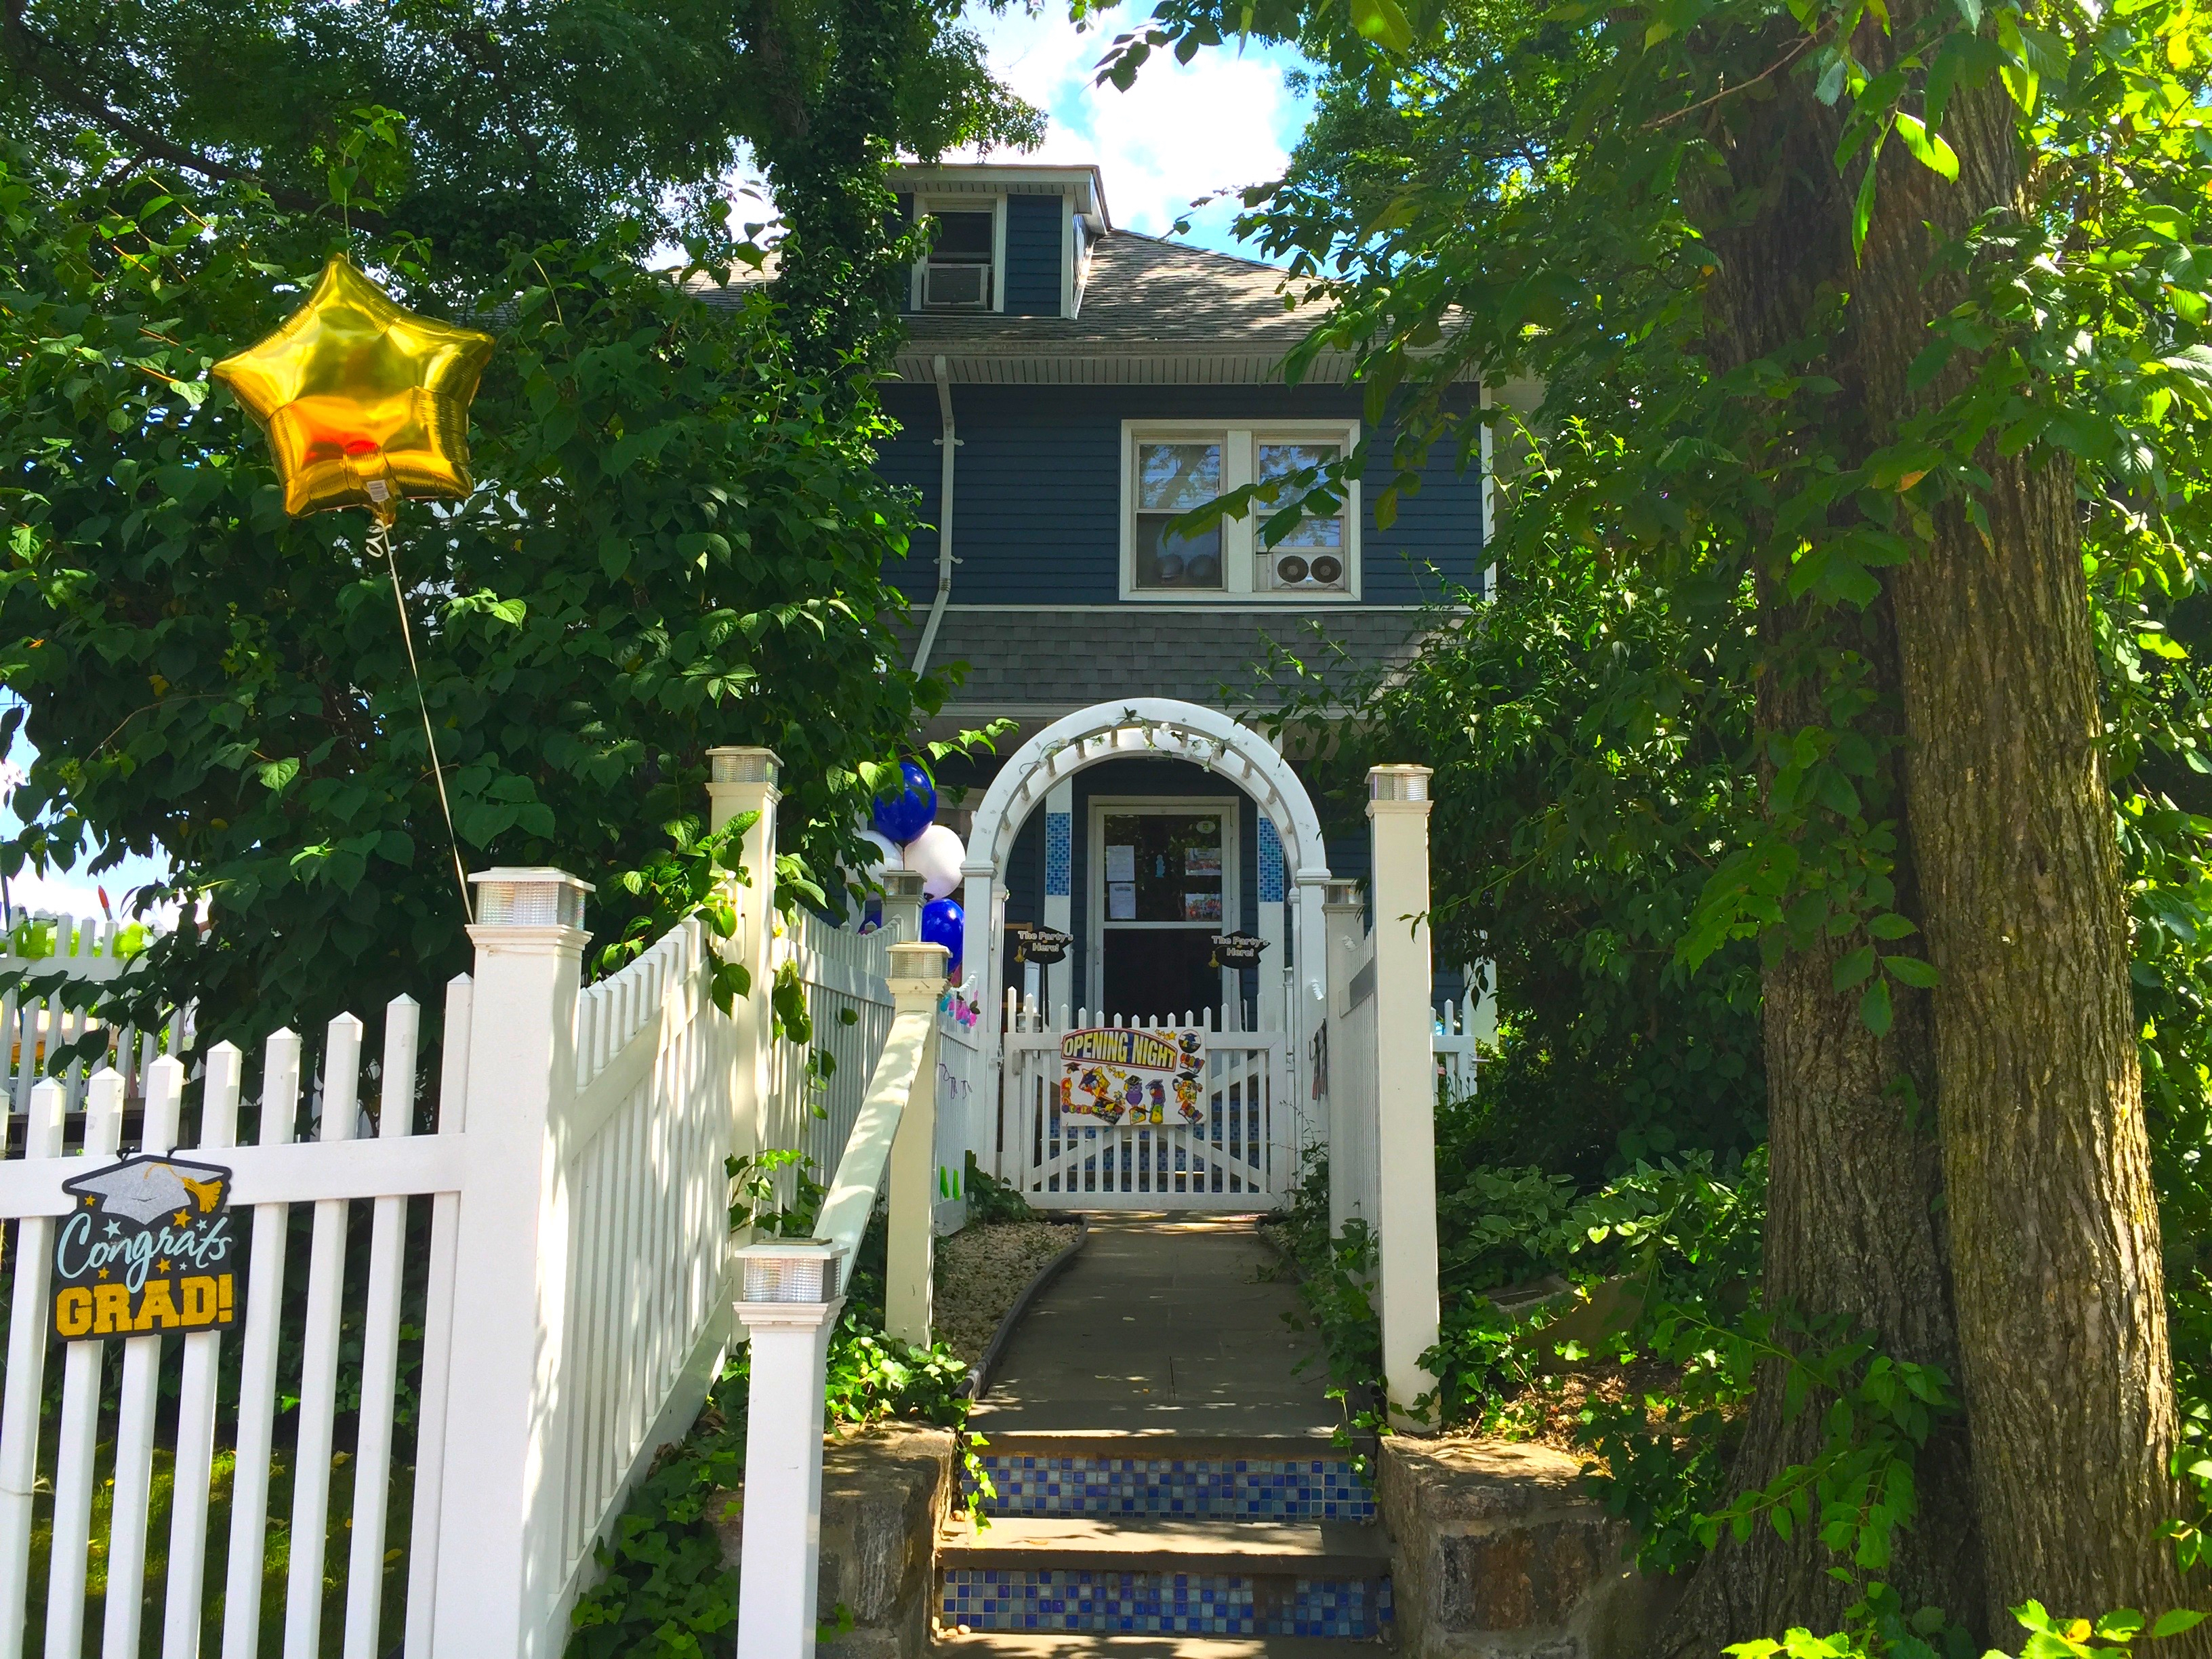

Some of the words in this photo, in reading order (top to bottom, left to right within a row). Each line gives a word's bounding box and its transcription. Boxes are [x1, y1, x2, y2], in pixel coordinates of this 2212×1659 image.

[1018, 930, 1038, 940] The
[1038, 931, 1074, 943] Party's
[1211, 935, 1231, 944] The
[1233, 937, 1269, 947] Party's
[1032, 942, 1059, 952] Here!
[1226, 947, 1254, 957] Here!
[1063, 1031, 1128, 1063] OPENING
[1132, 1036, 1176, 1068] NIGHT
[58, 1212, 232, 1294] Congrats
[56, 1273, 232, 1336] GRAD!
